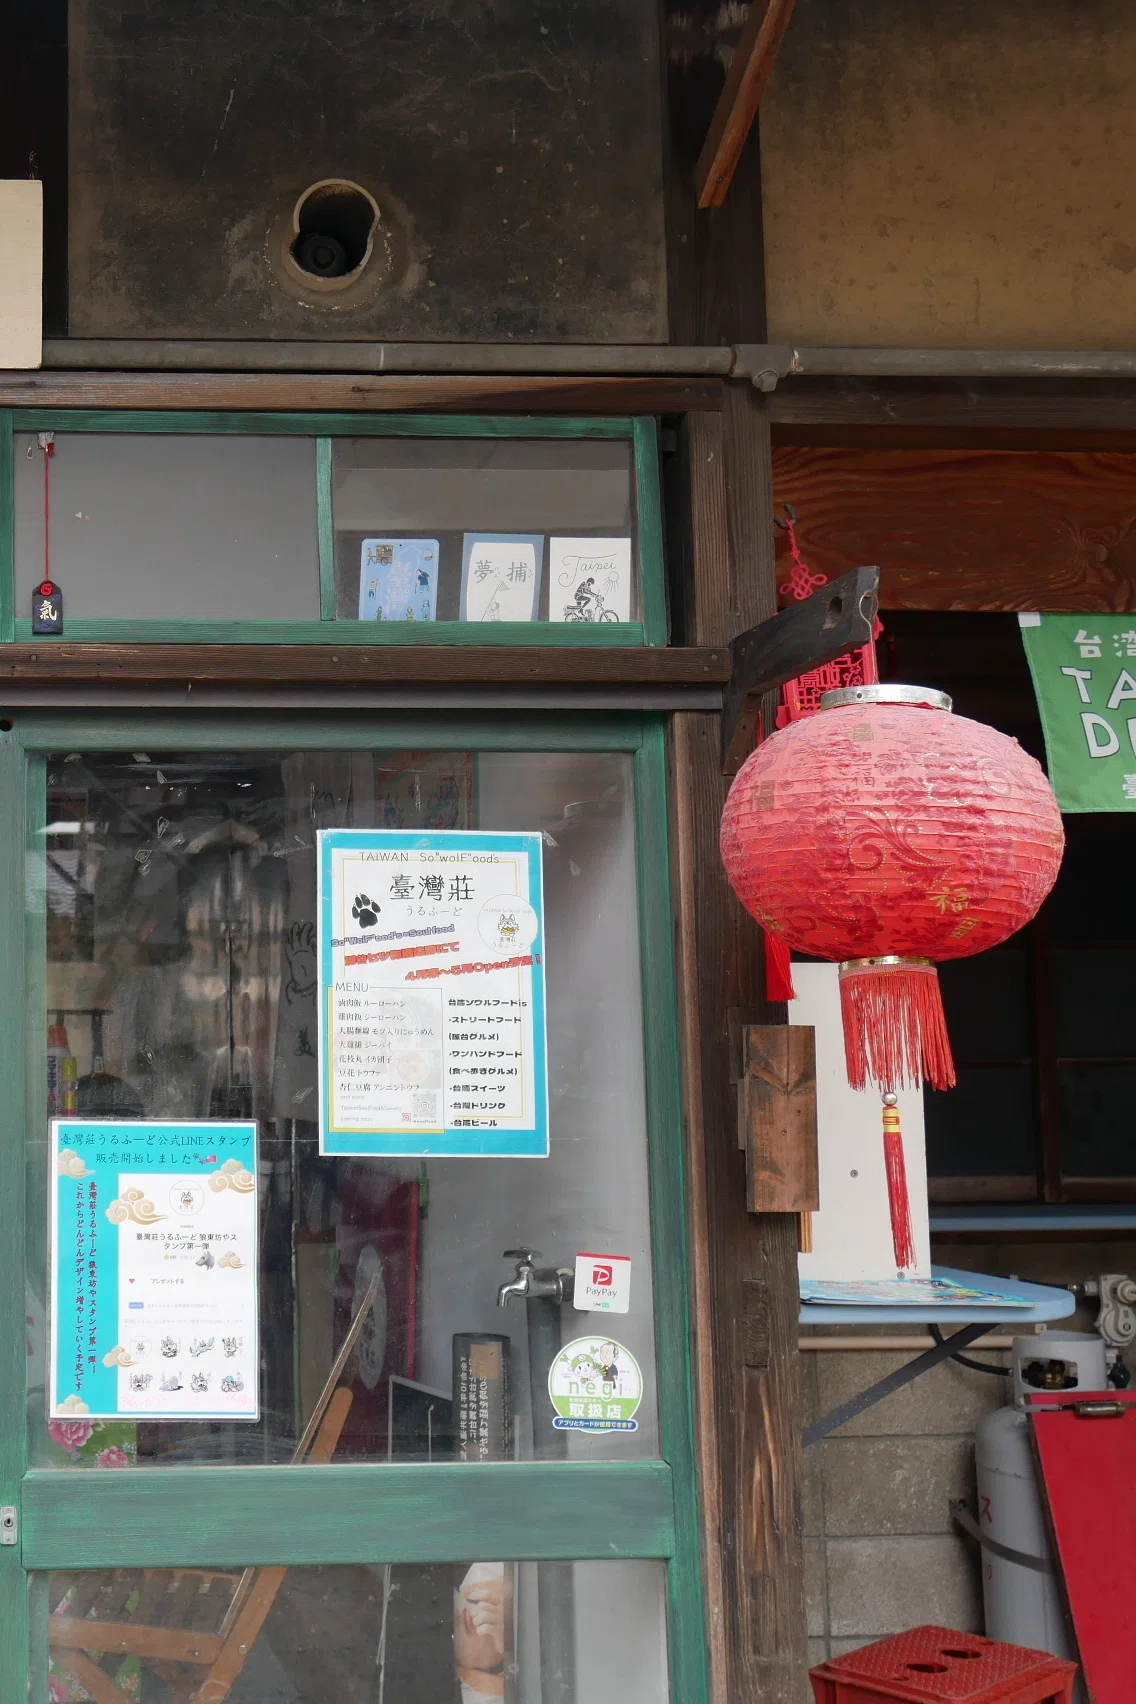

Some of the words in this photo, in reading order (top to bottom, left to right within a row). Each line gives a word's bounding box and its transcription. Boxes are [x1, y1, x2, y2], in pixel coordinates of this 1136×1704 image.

[558, 552, 619, 588] Taipei
[38, 600, 58, 623] 氣
[359, 852, 409, 862] TAIWAN
[390, 874, 475, 901] 臺灣莊
[407, 906, 463, 917] うるふーど
[335, 982, 369, 993] MENU
[364, 1000, 406, 1008] ルーローハン
[340, 1082, 371, 1091] 杏仁豆腐
[96, 1152, 191, 1165] 販売開始しました
[74, 1183, 85, 1391] これからどんどんデザイン増やしていく予定です
[586, 1287, 618, 1298] PayPay
[569, 1378, 623, 1400] negi
[569, 1403, 622, 1419] 取扱店
